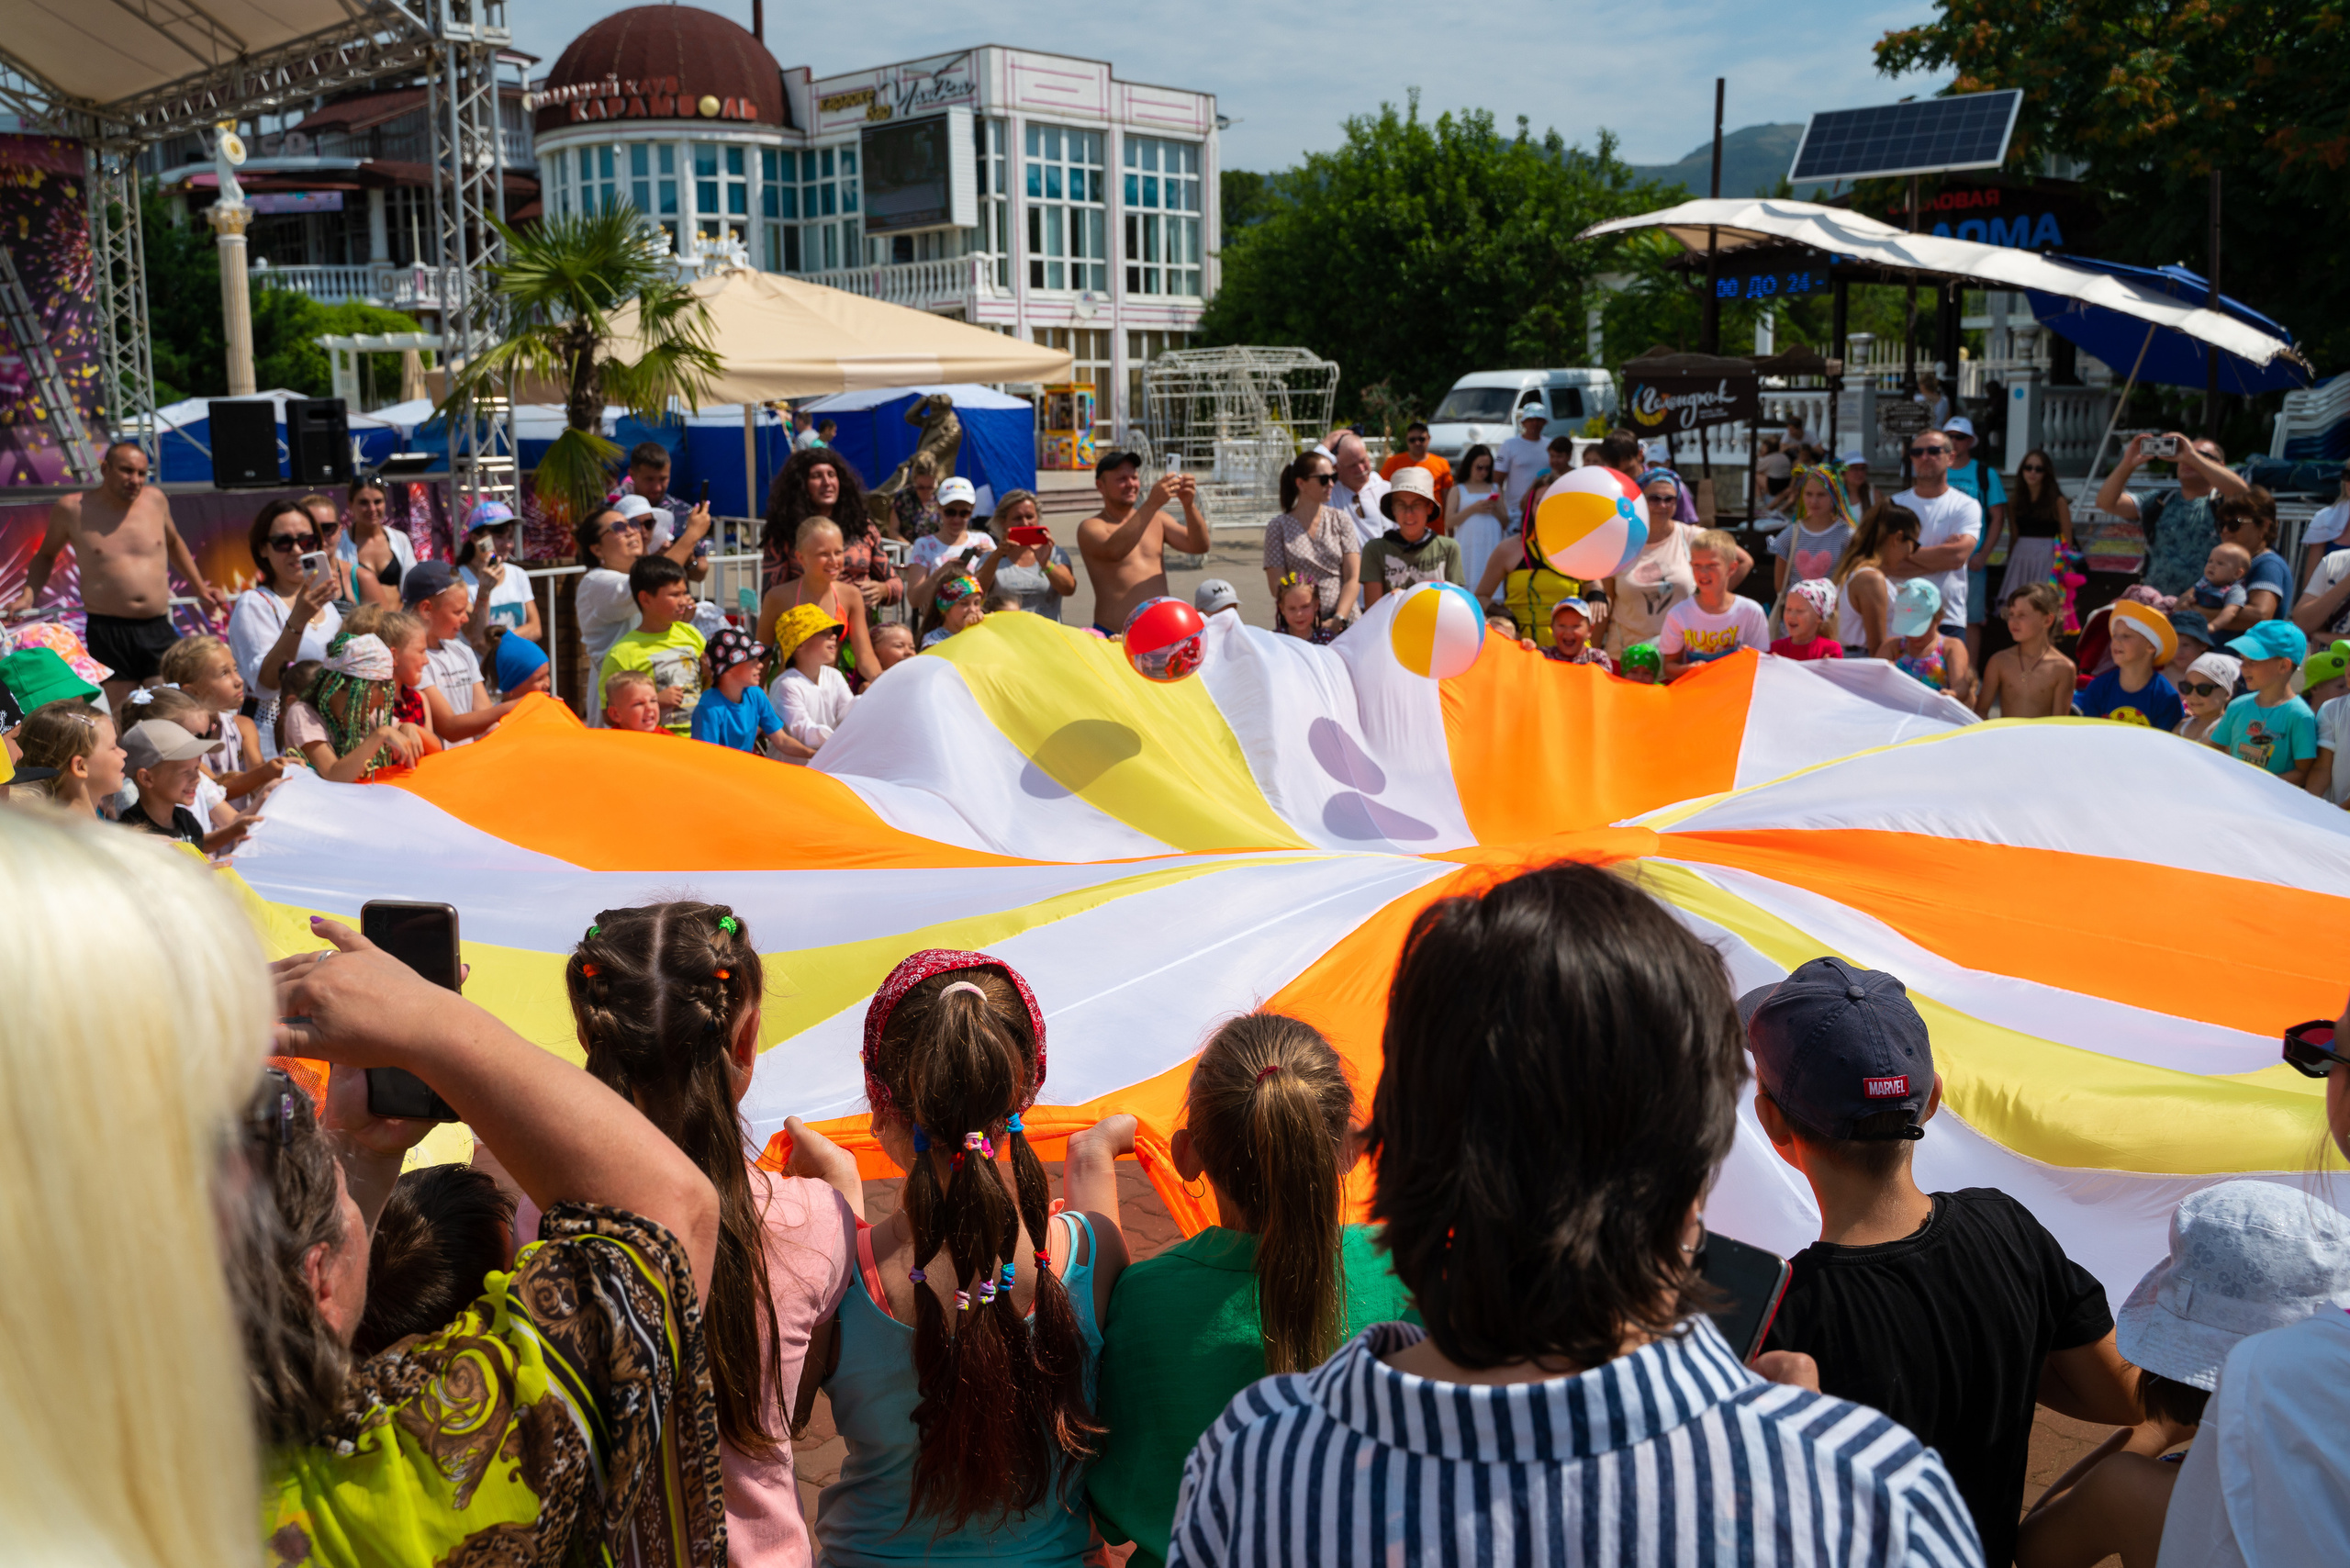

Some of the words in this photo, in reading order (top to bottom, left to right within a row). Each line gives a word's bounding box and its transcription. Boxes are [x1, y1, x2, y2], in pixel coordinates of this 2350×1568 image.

[1746, 274, 1777, 298] ДО
[1786, 272, 1810, 293] 24
[1869, 1080, 1906, 1095] MARVEL
